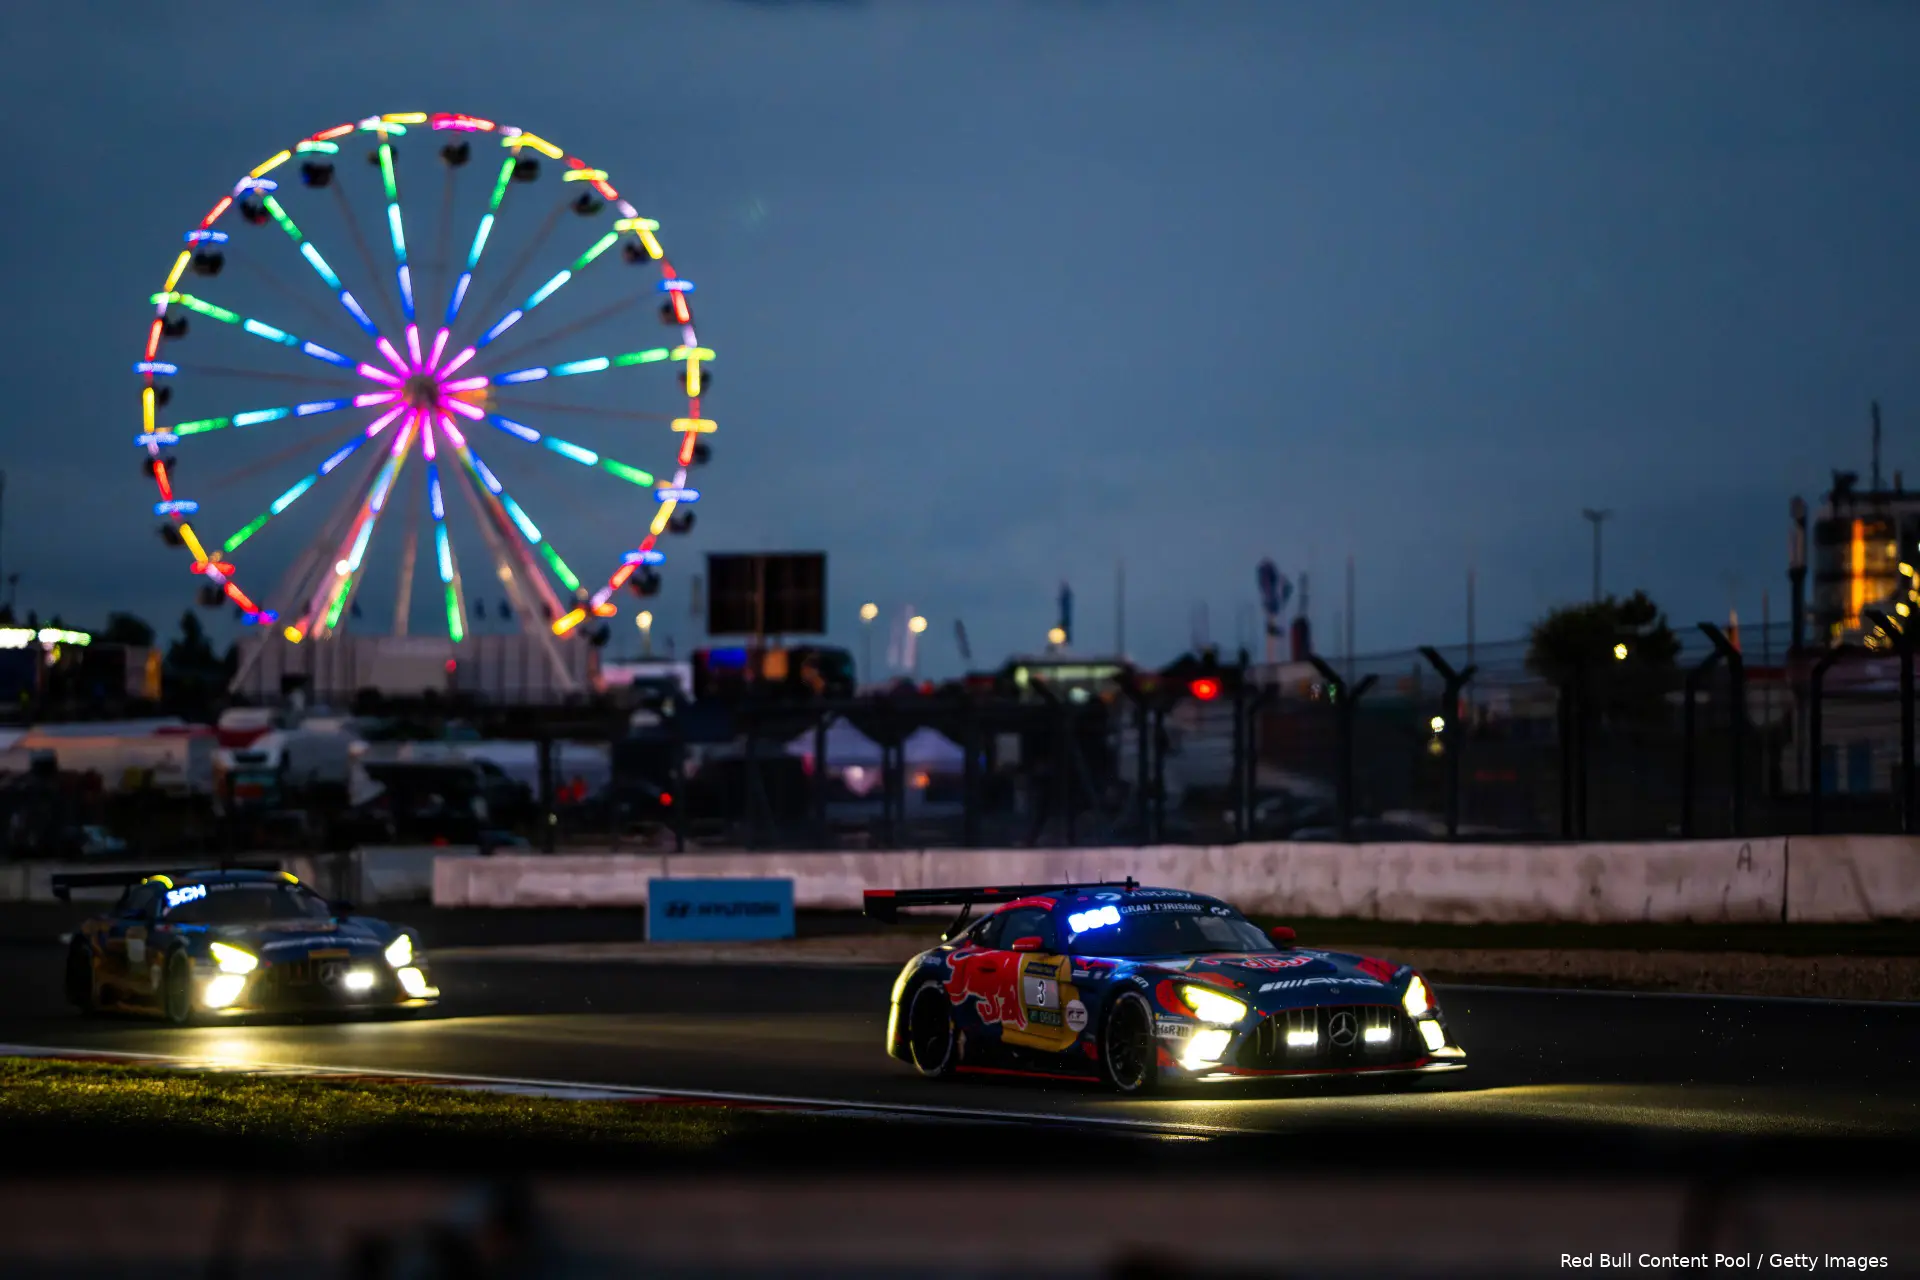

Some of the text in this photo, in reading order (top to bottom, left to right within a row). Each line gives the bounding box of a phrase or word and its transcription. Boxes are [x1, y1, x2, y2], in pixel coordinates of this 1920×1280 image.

[1121, 903, 1152, 915] GRAN
[1153, 902, 1204, 912] TURISMO
[1301, 977, 1384, 988] AMG
[1037, 980, 1046, 1006] 3
